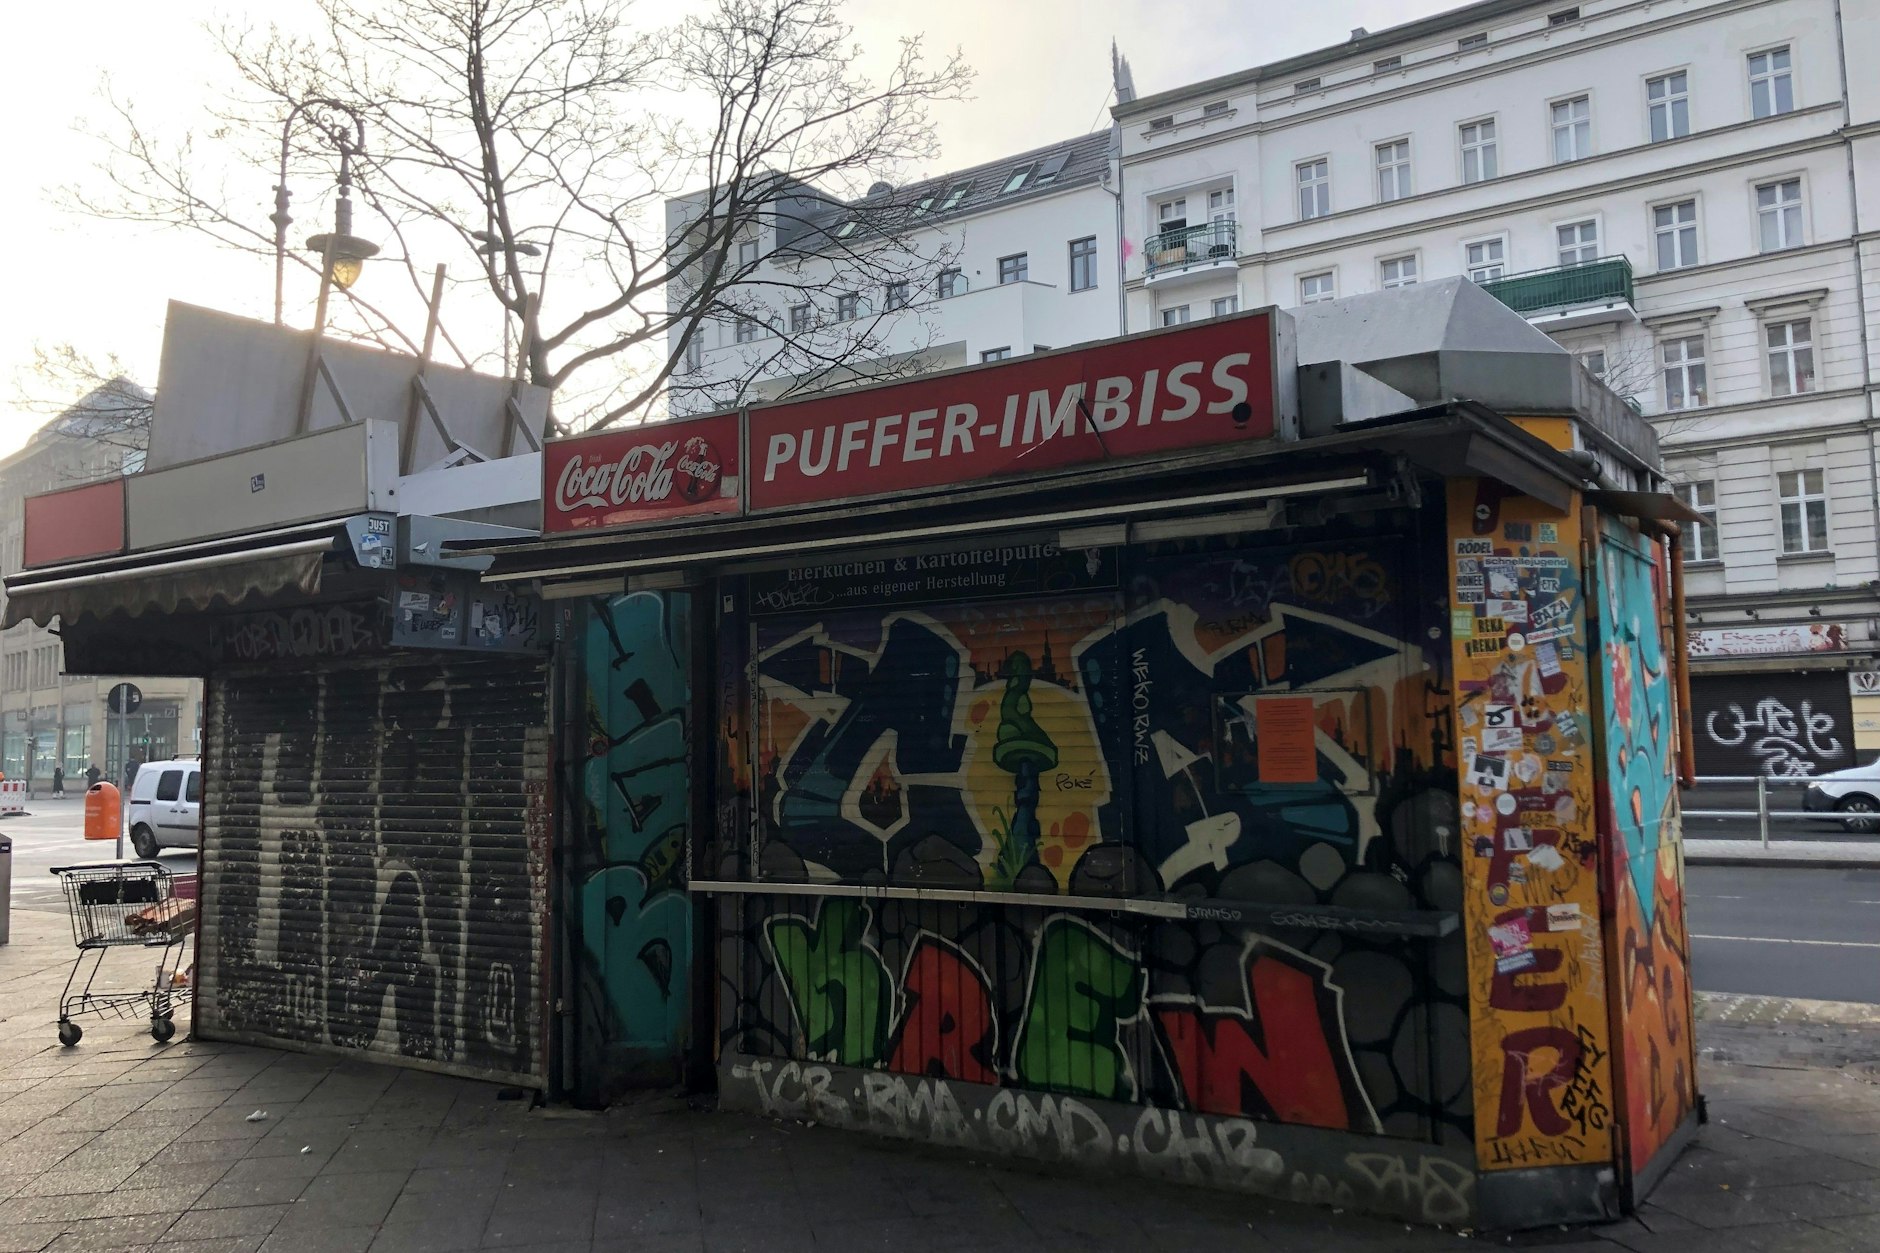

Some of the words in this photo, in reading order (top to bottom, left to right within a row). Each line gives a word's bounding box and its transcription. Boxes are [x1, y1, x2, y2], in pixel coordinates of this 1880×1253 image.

[763, 353, 1251, 482] PUFFER-IMBISS
[556, 440, 679, 512] Coca-Cola
[369, 519, 389, 531] JUST
[872, 580, 921, 596] eigener
[926, 571, 1007, 590] Herstellung
[1722, 628, 1800, 646] Eiscafé
